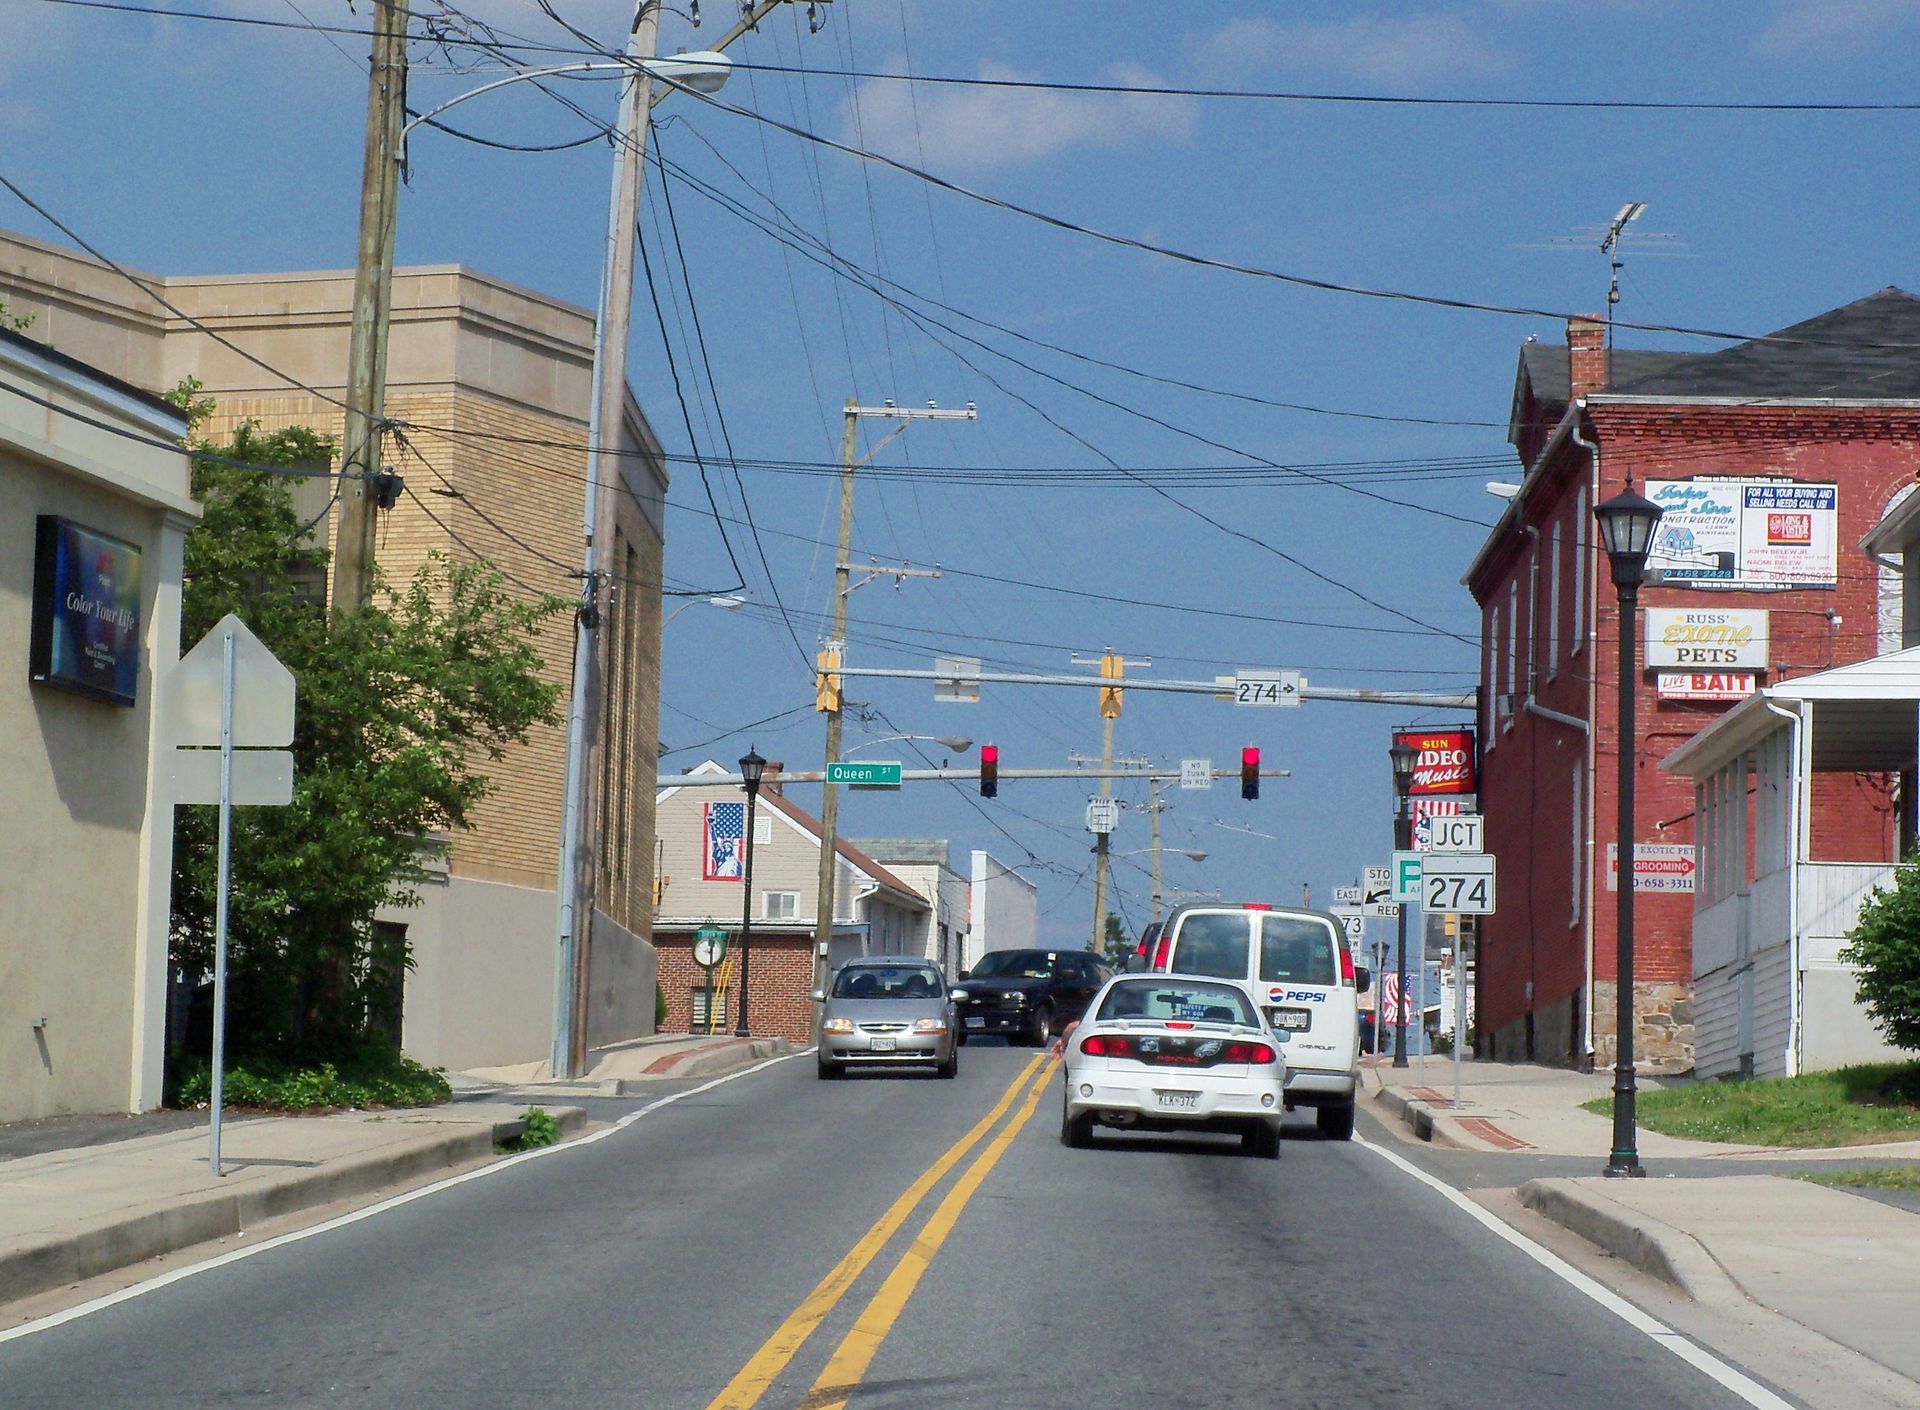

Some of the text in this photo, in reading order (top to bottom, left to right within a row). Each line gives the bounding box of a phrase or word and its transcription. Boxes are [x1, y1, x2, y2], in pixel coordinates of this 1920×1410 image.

[1653, 485, 1708, 500] John
[1748, 488, 1761, 497] FOR
[1762, 488, 1774, 497] ALL
[1775, 489, 1792, 498] YOUR
[1793, 489, 1817, 498] BUYING
[1818, 490, 1832, 499] AND
[1690, 500, 1732, 514] Son
[1749, 499, 1828, 509] SELLING NEEDS CALL US!
[1662, 516, 1736, 524] ONSTRUCTION
[1782, 515, 1801, 525] LONG
[1782, 525, 1809, 536] FOSTER
[67, 592, 134, 633] Color Your Life
[1686, 614, 1729, 624] RUSS'
[1663, 625, 1752, 647] EXOTIC
[1676, 648, 1738, 662] PETS
[1663, 674, 1750, 691] LIVE BAIT
[1239, 683, 1277, 702] 274
[1422, 739, 1448, 749] SUN
[1417, 750, 1467, 766] IDEO
[834, 767, 872, 779] Queen
[1413, 766, 1469, 786] Music
[1436, 823, 1477, 846] JCT
[1640, 847, 1675, 855] EXOTIC
[1634, 862, 1689, 872] GROOMING
[1369, 870, 1391, 879] STO
[1633, 878, 1693, 888] 0-658-3311
[1336, 890, 1358, 899] EAST
[1429, 878, 1487, 909] 274
[1377, 905, 1399, 916] RED
[1342, 917, 1361, 933] 73
[1286, 991, 1326, 1002] PEPSI
